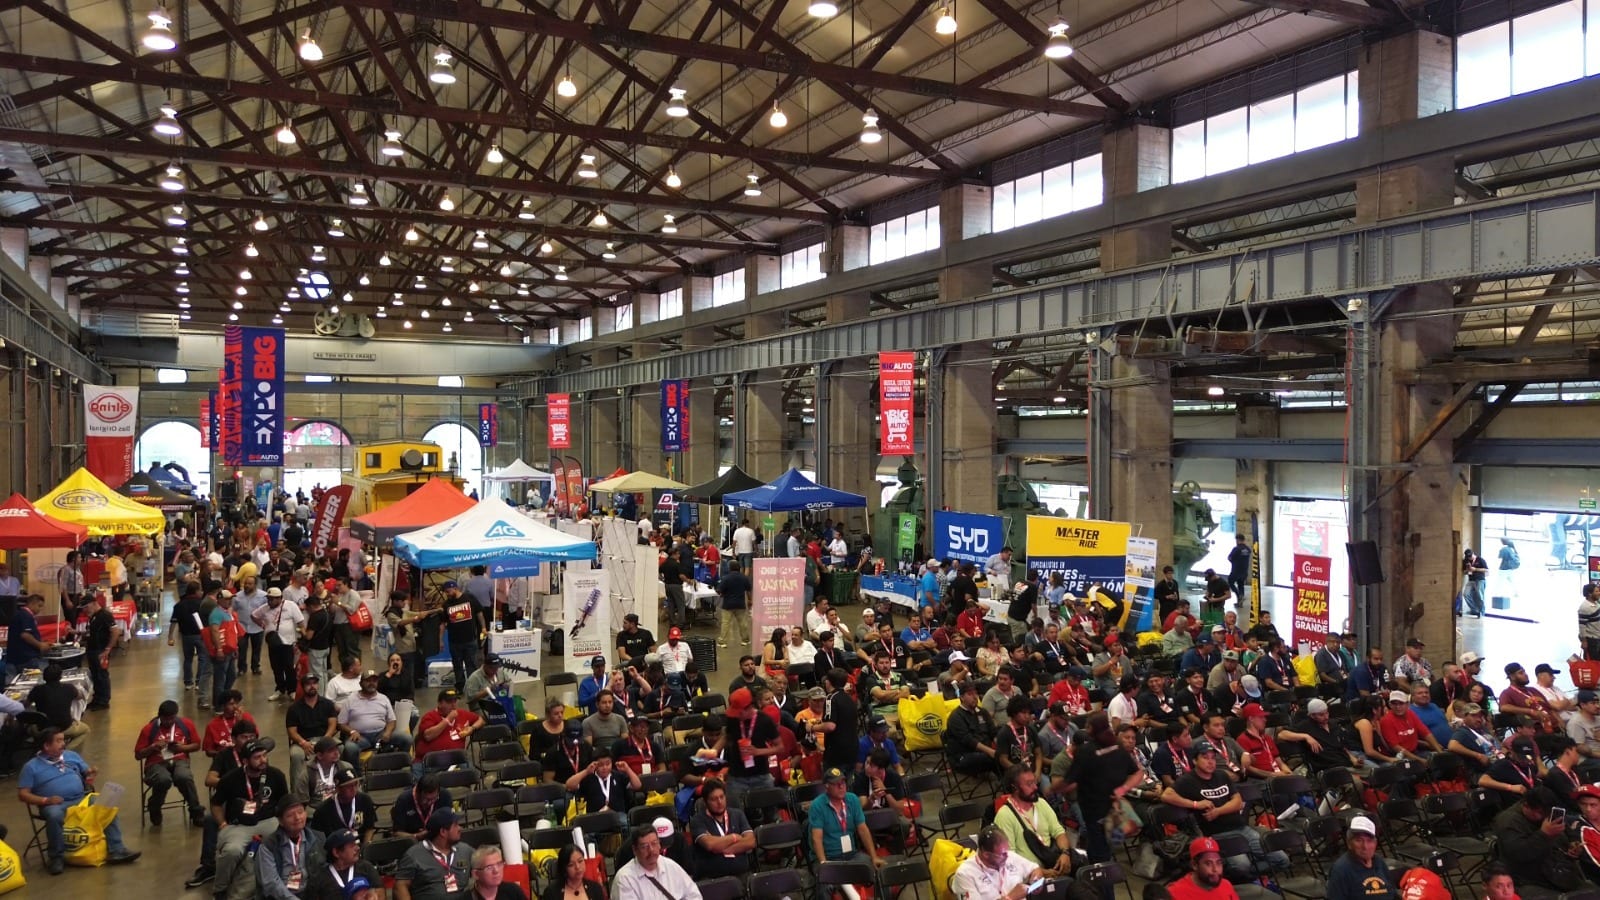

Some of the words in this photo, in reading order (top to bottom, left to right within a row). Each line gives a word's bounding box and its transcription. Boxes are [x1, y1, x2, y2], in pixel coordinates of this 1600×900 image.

[253, 335, 277, 379] BIG
[253, 381, 276, 445] EXPO
[314, 494, 341, 559] GONHER
[490, 525, 518, 537] AG
[949, 525, 988, 553] SYD
[1056, 527, 1100, 540] MASTER
[1079, 540, 1098, 548] RIDE
[1305, 565, 1323, 573] CLOYES
[1321, 592, 1325, 600] A
[1297, 599, 1328, 615] CENAR
[1295, 621, 1328, 634] GRANDE
[918, 719, 942, 729] HELLA
